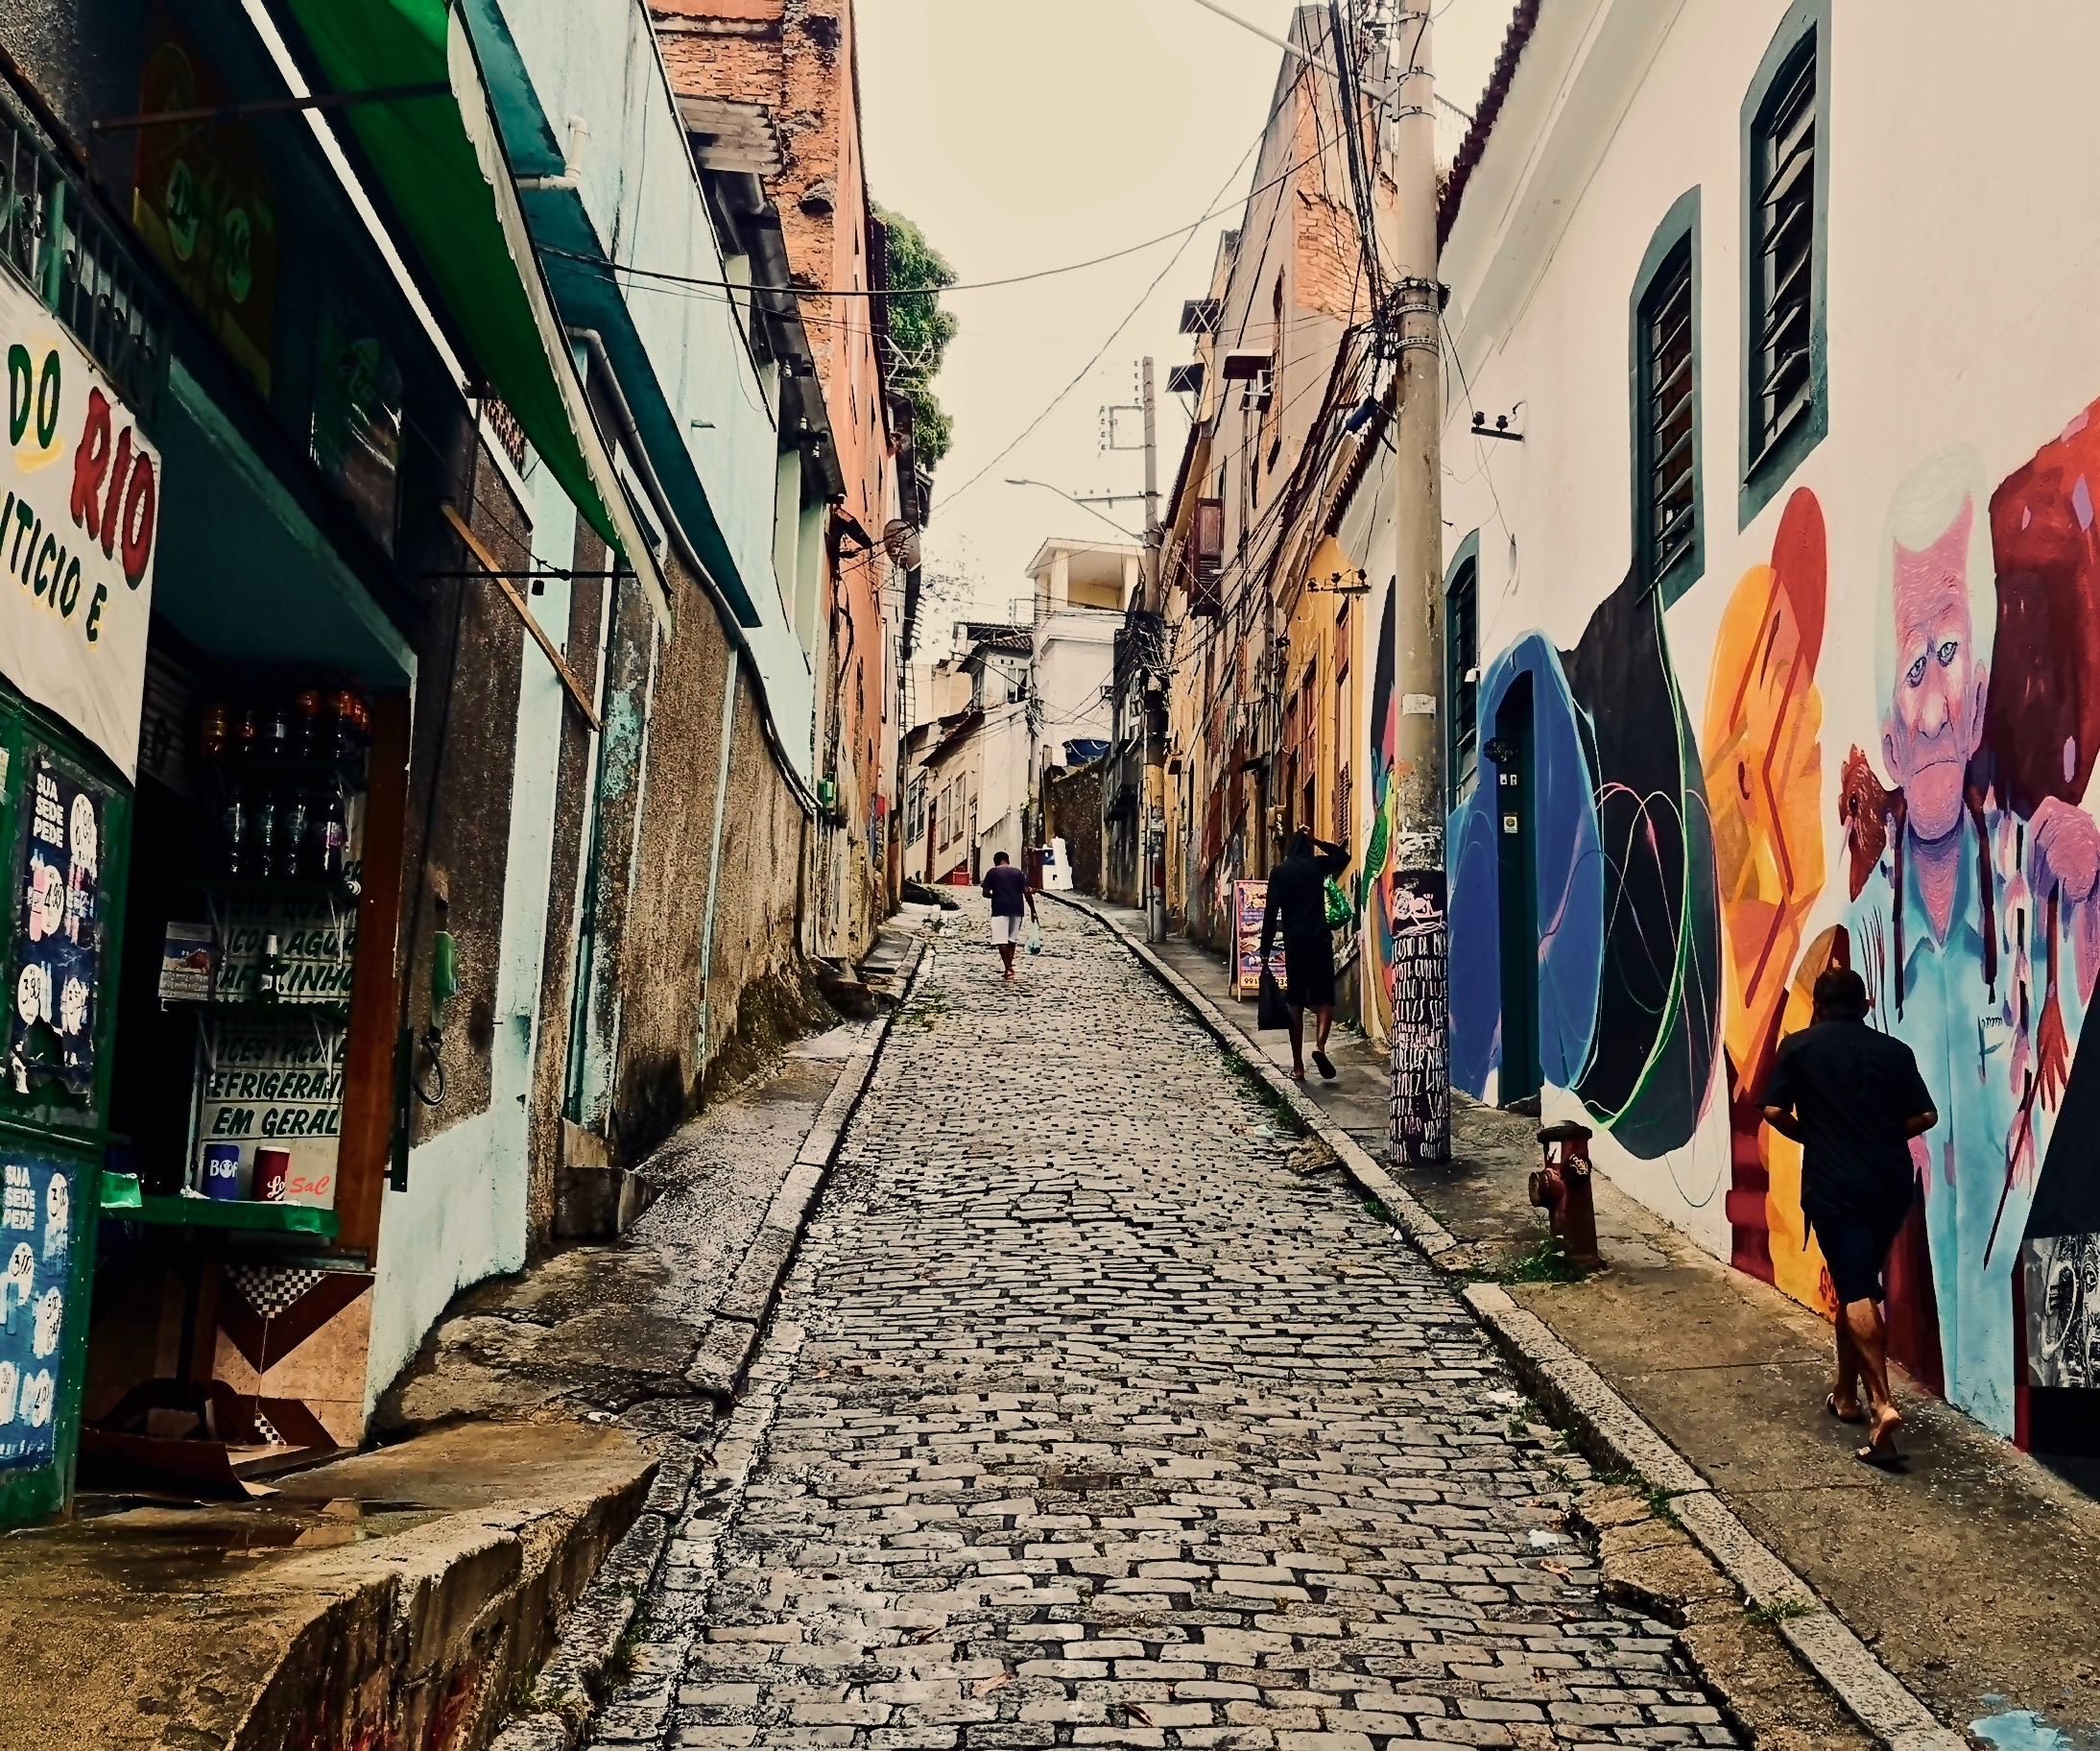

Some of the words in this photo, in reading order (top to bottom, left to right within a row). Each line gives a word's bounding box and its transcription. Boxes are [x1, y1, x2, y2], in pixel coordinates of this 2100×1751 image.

[8, 344, 61, 450] DO
[70, 385, 155, 590] RIO
[85, 582, 107, 643] E
[36, 772, 59, 803] SUA
[35, 794, 64, 827] SEDE
[33, 816, 63, 849] PEDE
[210, 1071, 344, 1101] EFRIGERAN
[211, 1106, 255, 1136] EM
[261, 1107, 339, 1138] GERAL
[4, 1164, 31, 1188] SUA
[289, 1176, 330, 1196] SaC
[3, 1186, 36, 1210] SEDE
[2, 1208, 36, 1231] PEDE
